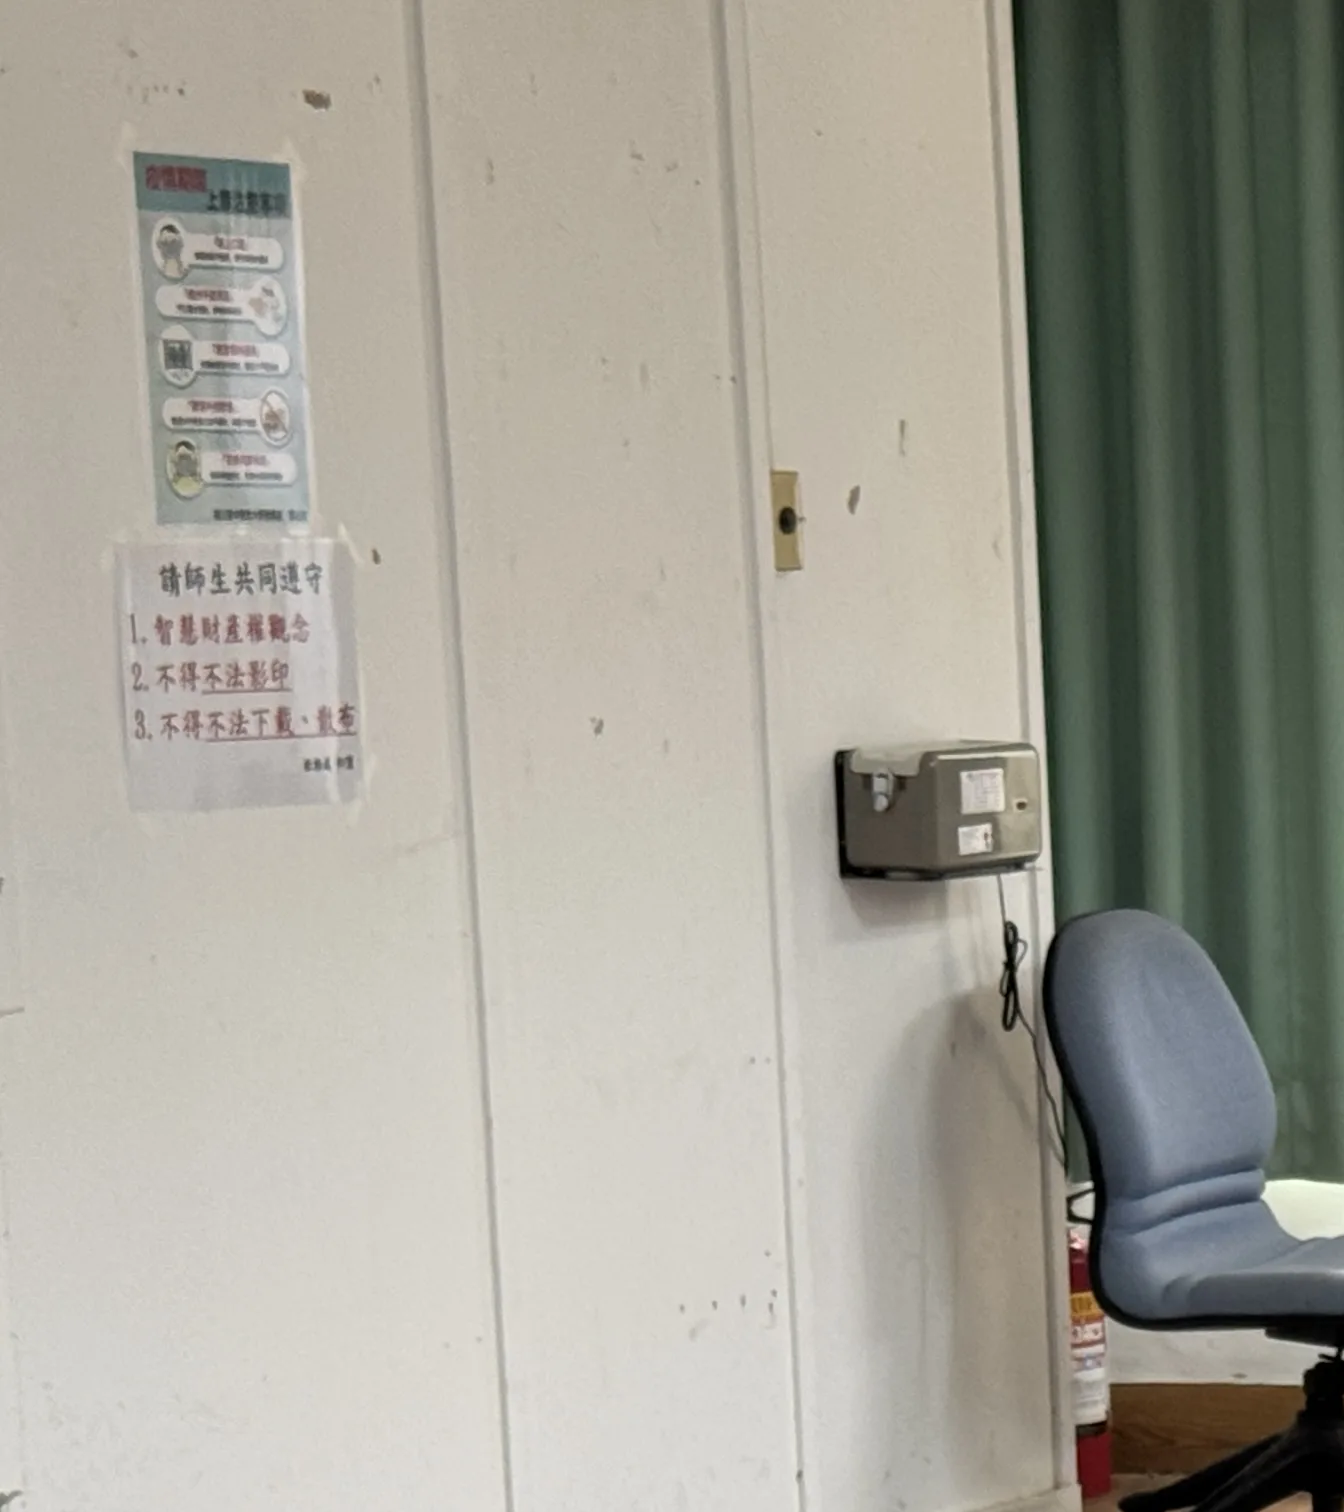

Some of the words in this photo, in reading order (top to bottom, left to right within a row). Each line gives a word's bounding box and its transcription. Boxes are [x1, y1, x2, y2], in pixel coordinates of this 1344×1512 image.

[159, 561, 324, 597] 請師生共同遵守
